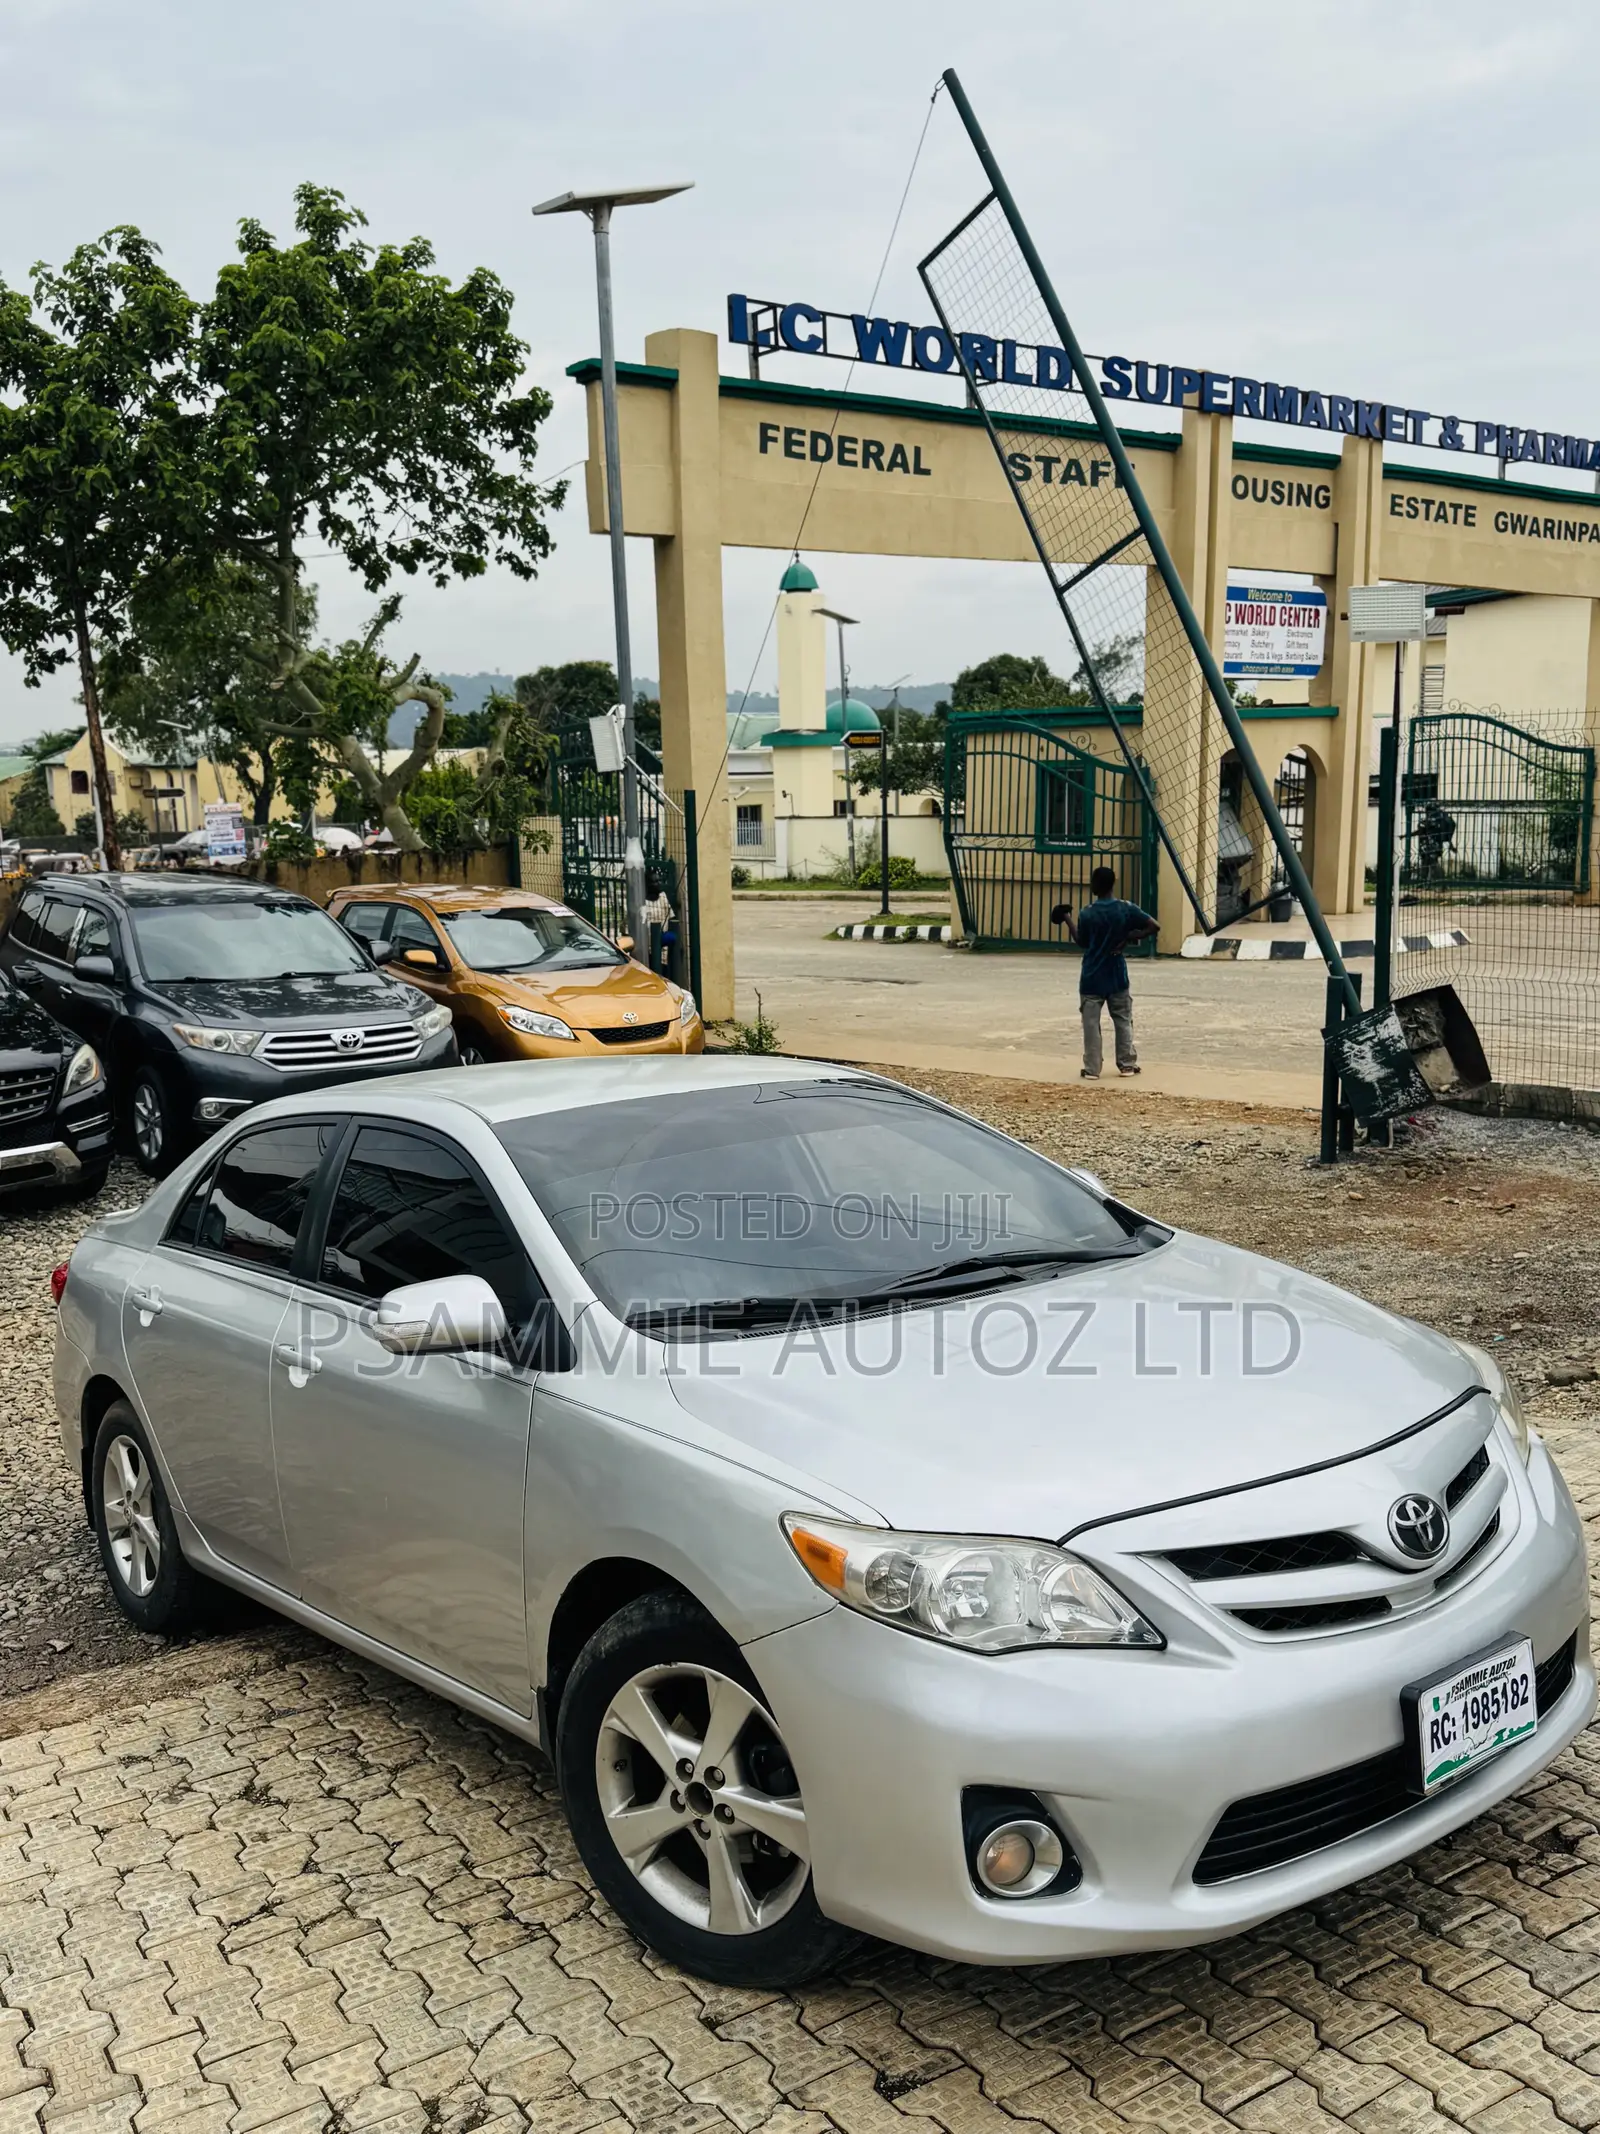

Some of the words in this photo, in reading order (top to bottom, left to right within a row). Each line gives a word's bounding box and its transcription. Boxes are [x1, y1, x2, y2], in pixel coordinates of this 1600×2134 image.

[850, 314, 1072, 390] WORLD
[1100, 356, 1431, 443] SUPERMARKET
[1438, 415, 1465, 451] &
[759, 422, 932, 476] FEDERAL
[1231, 474, 1331, 510] OUSING
[1389, 493, 1477, 528] ESTATE
[1494, 510, 1600, 544] GWARINPA
[1247, 588, 1283, 602] Welcome
[1284, 592, 1293, 603] to
[1235, 604, 1276, 626] WORLD
[1280, 606, 1320, 628] CENTER
[1224, 629, 1248, 638] ermarket
[1224, 652, 1243, 660] taurant
[1451, 1668, 1488, 1699] PSAMMIE
[1430, 1711, 1457, 1754] RC:
[1462, 1673, 1529, 1734] 1985182
